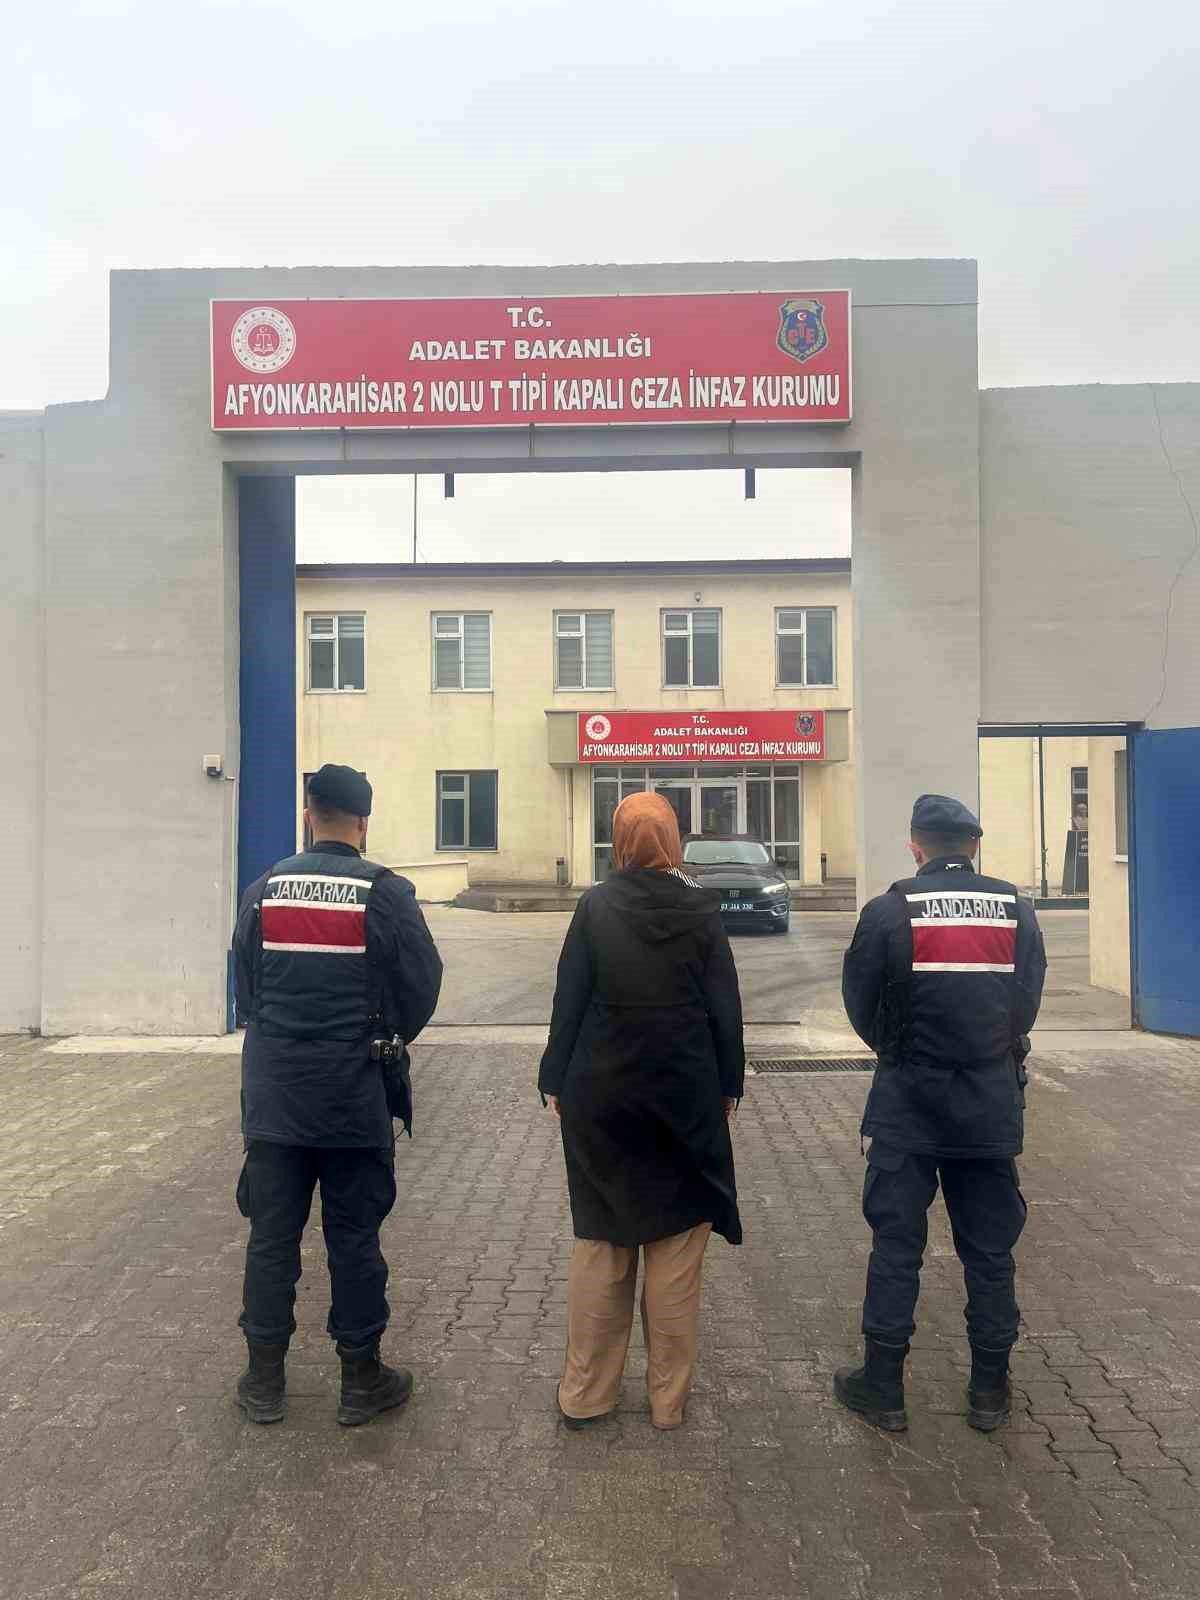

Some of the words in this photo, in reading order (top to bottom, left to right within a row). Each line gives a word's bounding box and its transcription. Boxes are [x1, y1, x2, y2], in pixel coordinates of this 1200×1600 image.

[507, 306, 552, 328] T.C.
[408, 340, 506, 361] ADALET
[514, 332, 652, 360] BAKANLIĞI
[224, 373, 407, 415] AFYONKARAHİSAR
[412, 381, 424, 413] 2
[430, 380, 484, 412] NOLU
[490, 380, 503, 411] T
[508, 371, 547, 411] TİPİ
[553, 378, 624, 410] KAPALI
[630, 377, 683, 409] CEZA
[689, 369, 747, 408] İNFAZ
[752, 374, 840, 407] KURUMU
[692, 715, 710, 724] T.C.
[653, 727, 692, 736] ADALET
[694, 725, 748, 736] BAKANLIĞI
[583, 739, 653, 757] AFYONKARAHİSAR
[655, 744, 660, 756] 2
[661, 743, 683, 756] NOLU
[692, 740, 708, 756] TİPİ
[709, 742, 737, 756] KAPALI
[739, 742, 760, 755] CEZA
[761, 739, 784, 755] İNFAZ
[786, 741, 821, 755] KURUMU
[271, 880, 358, 904] JANDARMA
[921, 898, 1008, 919] JANDARMA
